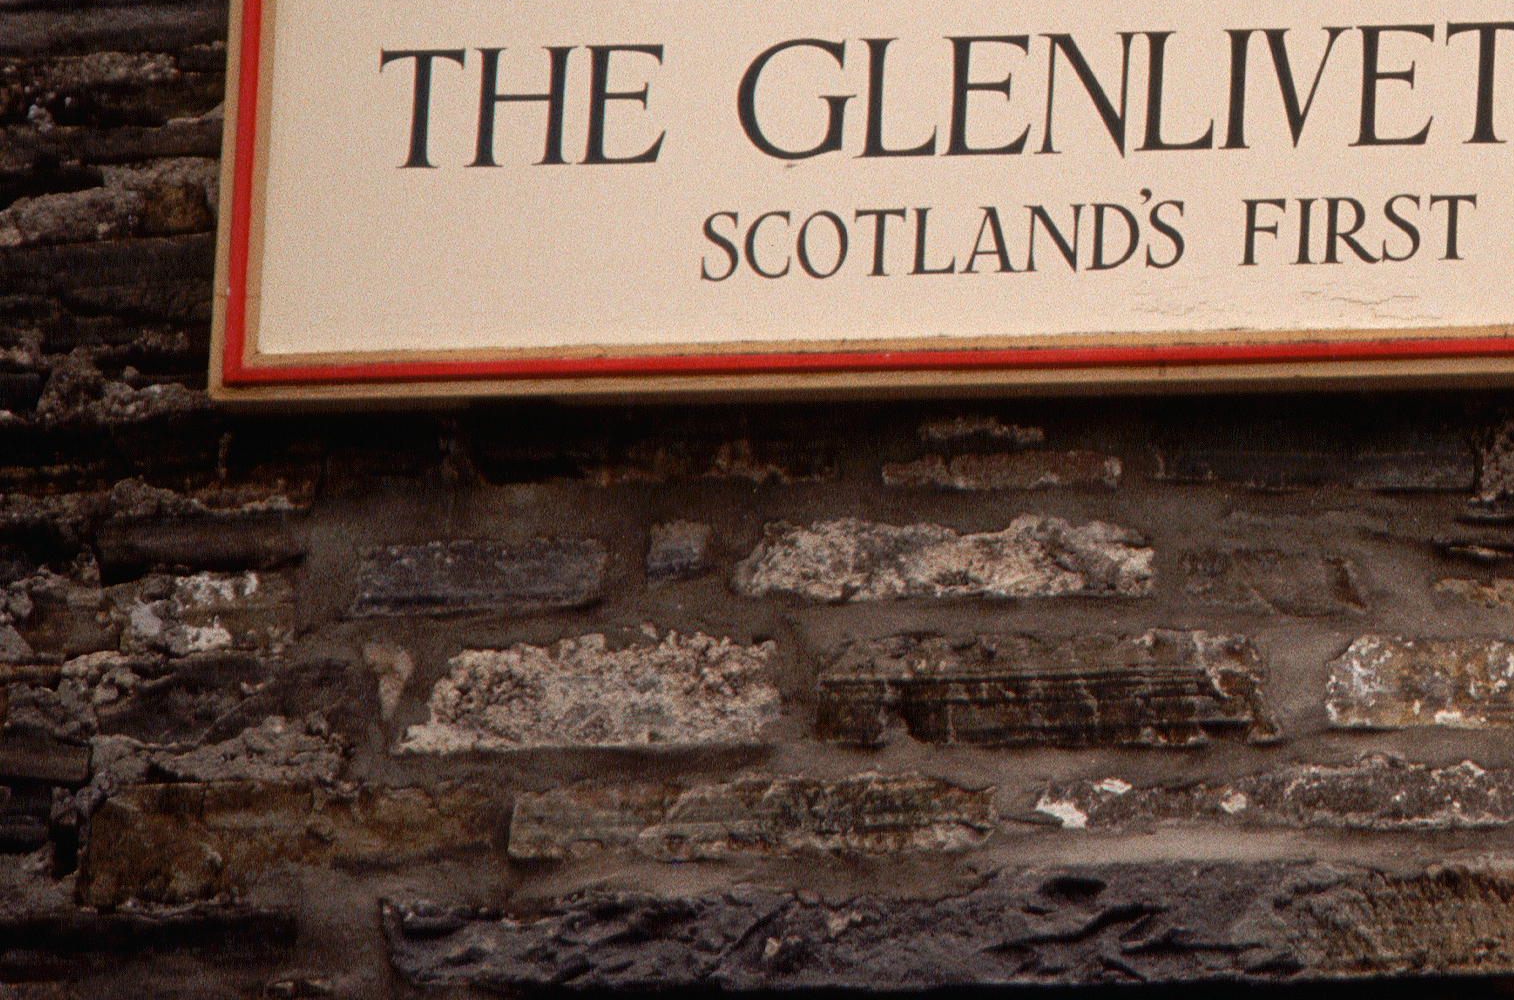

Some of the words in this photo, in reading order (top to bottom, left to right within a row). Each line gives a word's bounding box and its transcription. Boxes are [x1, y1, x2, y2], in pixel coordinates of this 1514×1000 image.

[379, 44, 665, 169] THE
[701, 189, 1184, 282] SCOTLAND'S
[1241, 194, 1476, 266] FIRST
